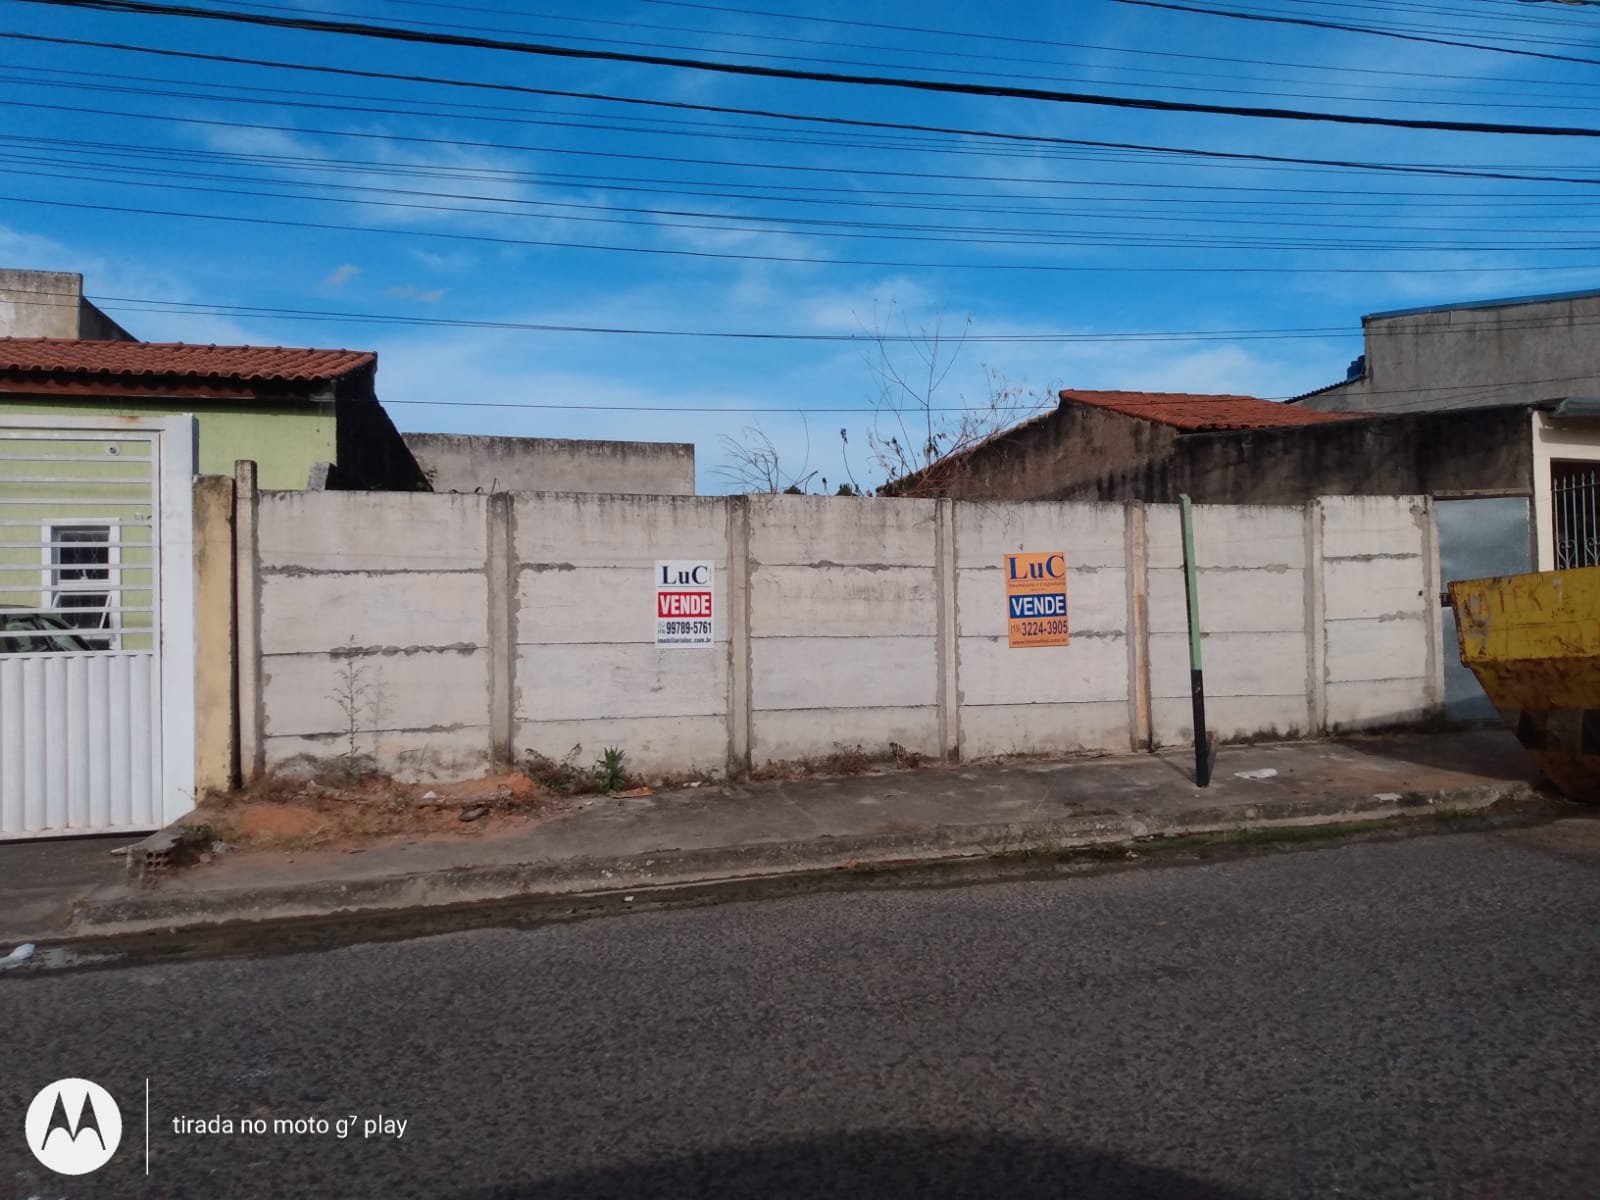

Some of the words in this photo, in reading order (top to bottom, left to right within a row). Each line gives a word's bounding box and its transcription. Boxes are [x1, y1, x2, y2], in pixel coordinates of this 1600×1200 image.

[661, 565, 708, 585] LuC
[1008, 555, 1065, 579] LuC
[660, 595, 711, 615] VENDE
[1011, 596, 1065, 616] VENDE
[666, 621, 712, 635] 99789-5761
[1022, 620, 1068, 636] 3224-3905
